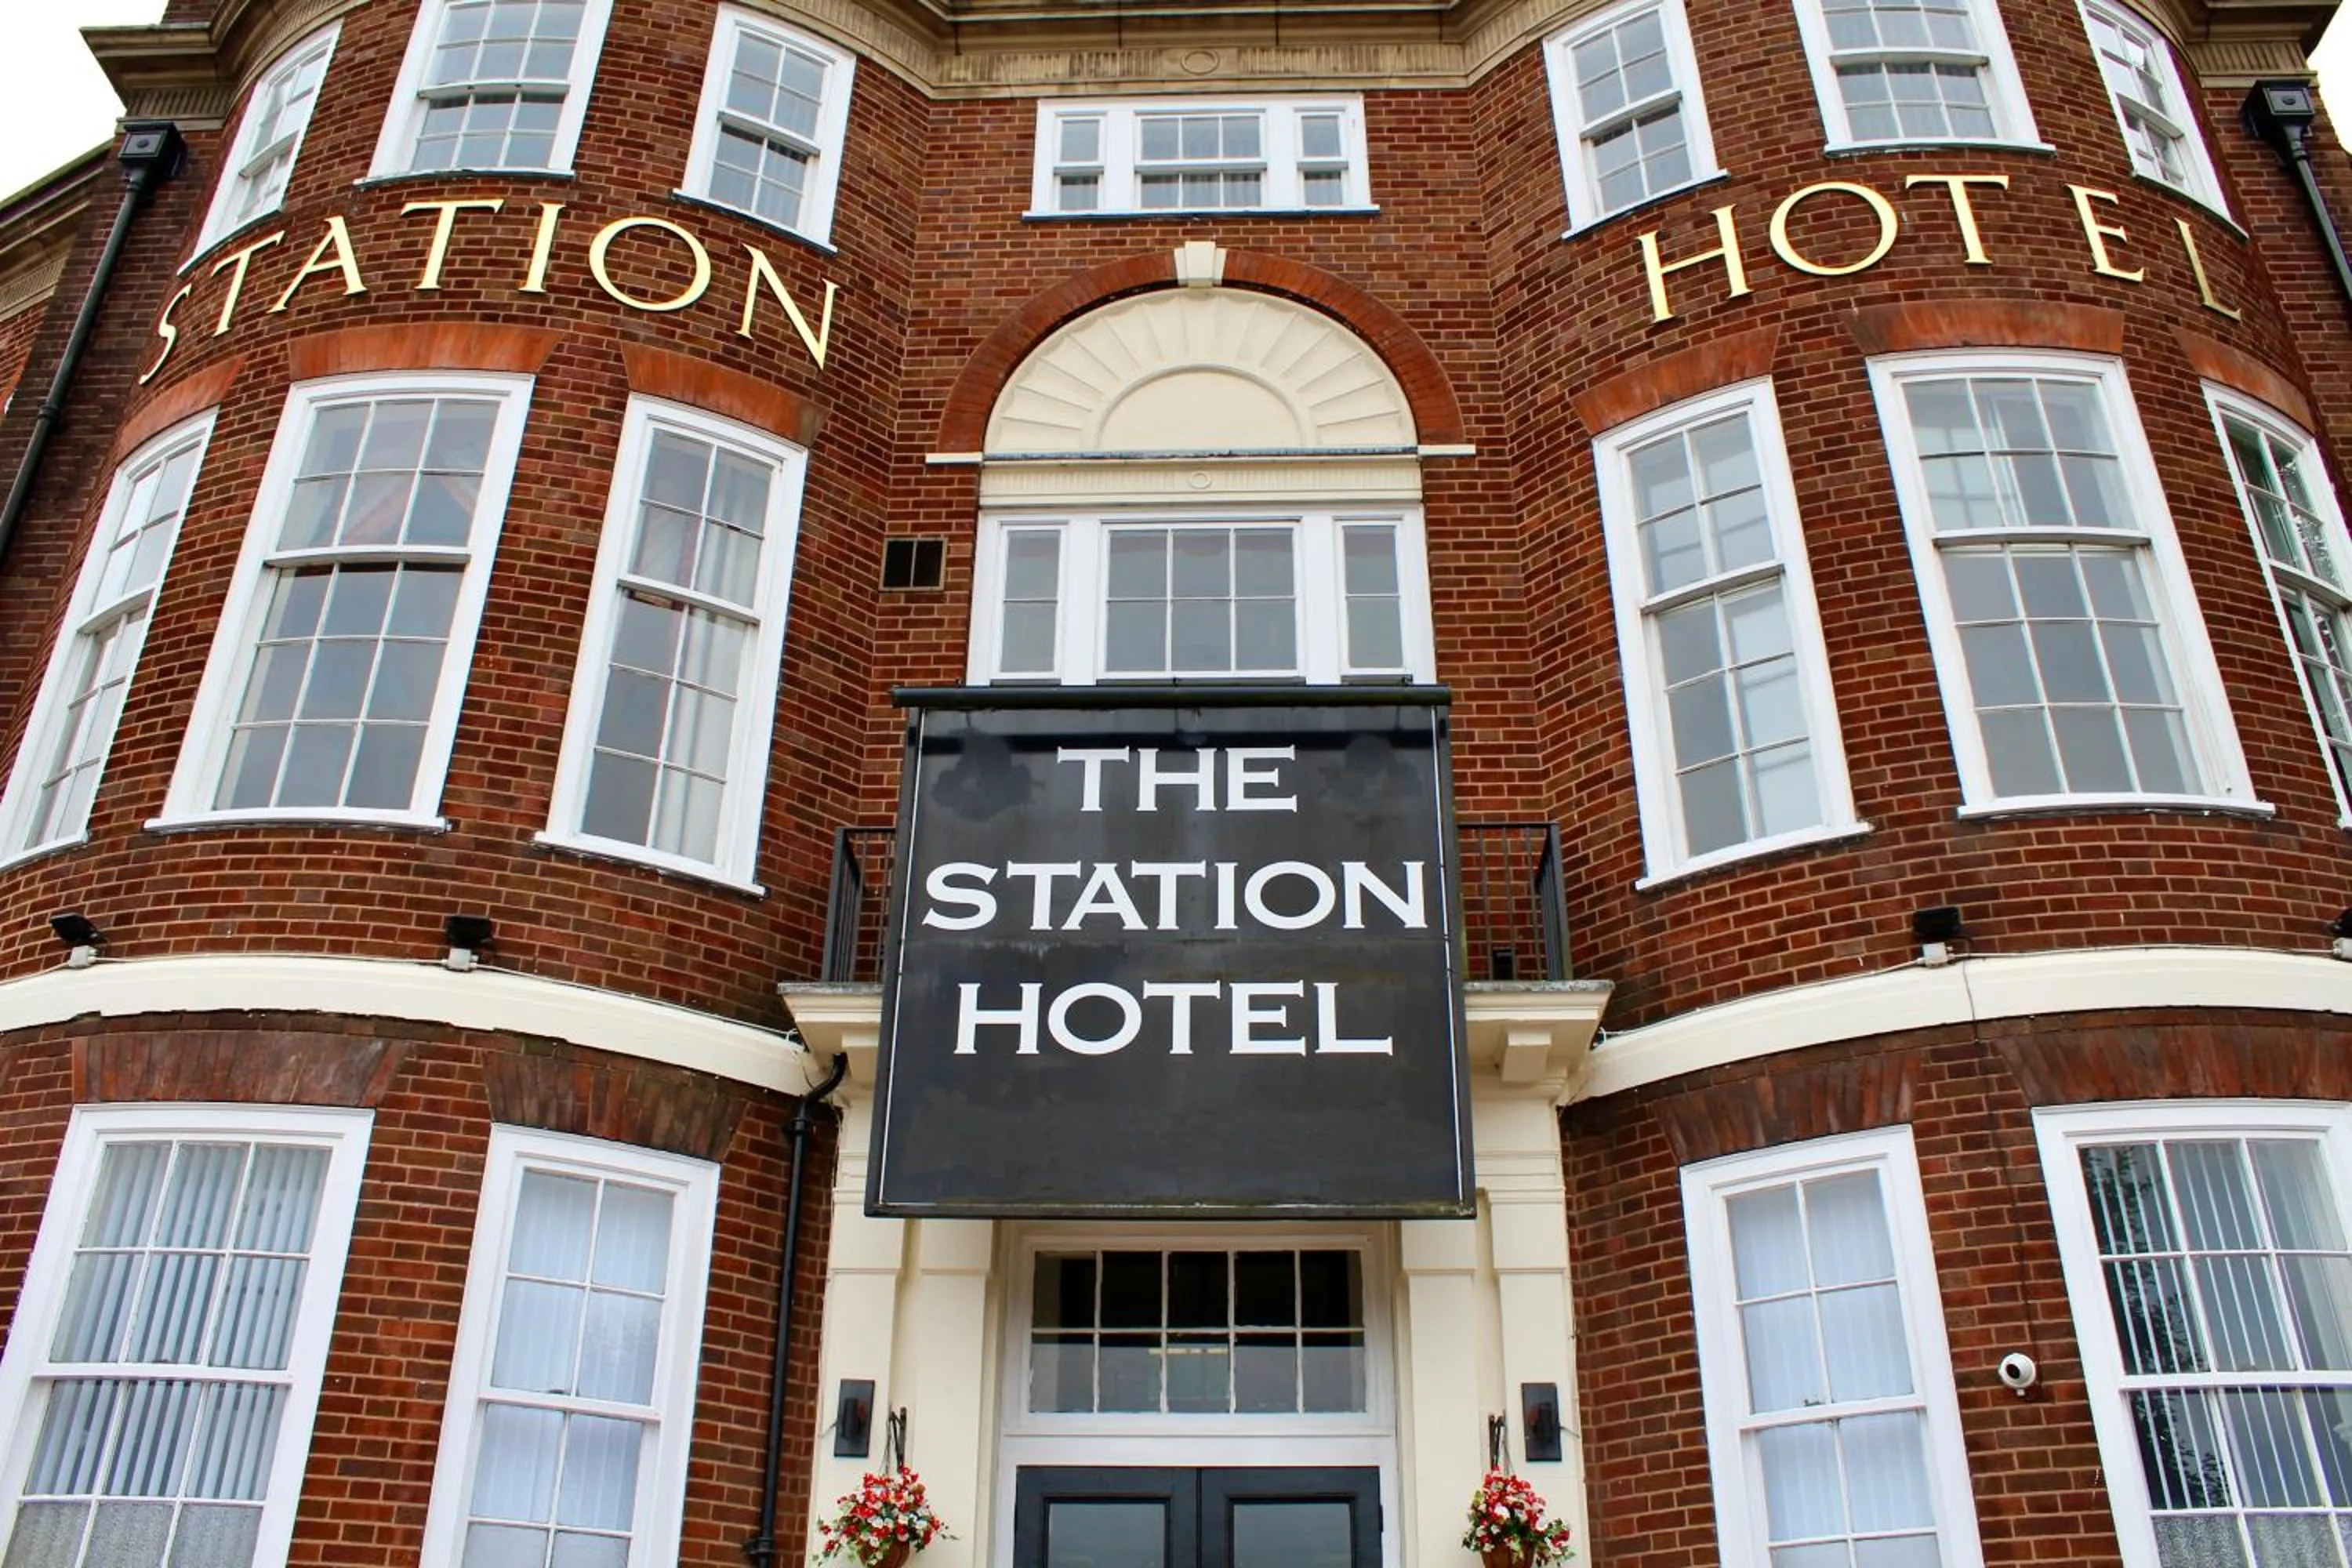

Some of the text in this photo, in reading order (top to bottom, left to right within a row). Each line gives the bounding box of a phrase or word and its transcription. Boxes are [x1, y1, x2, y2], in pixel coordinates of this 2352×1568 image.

[1636, 175, 2241, 324] HOTEL
[139, 198, 840, 385] STATION
[1057, 745, 1298, 813] THE
[922, 860, 1428, 931] STATION
[953, 979, 1393, 1055] HOTEL
